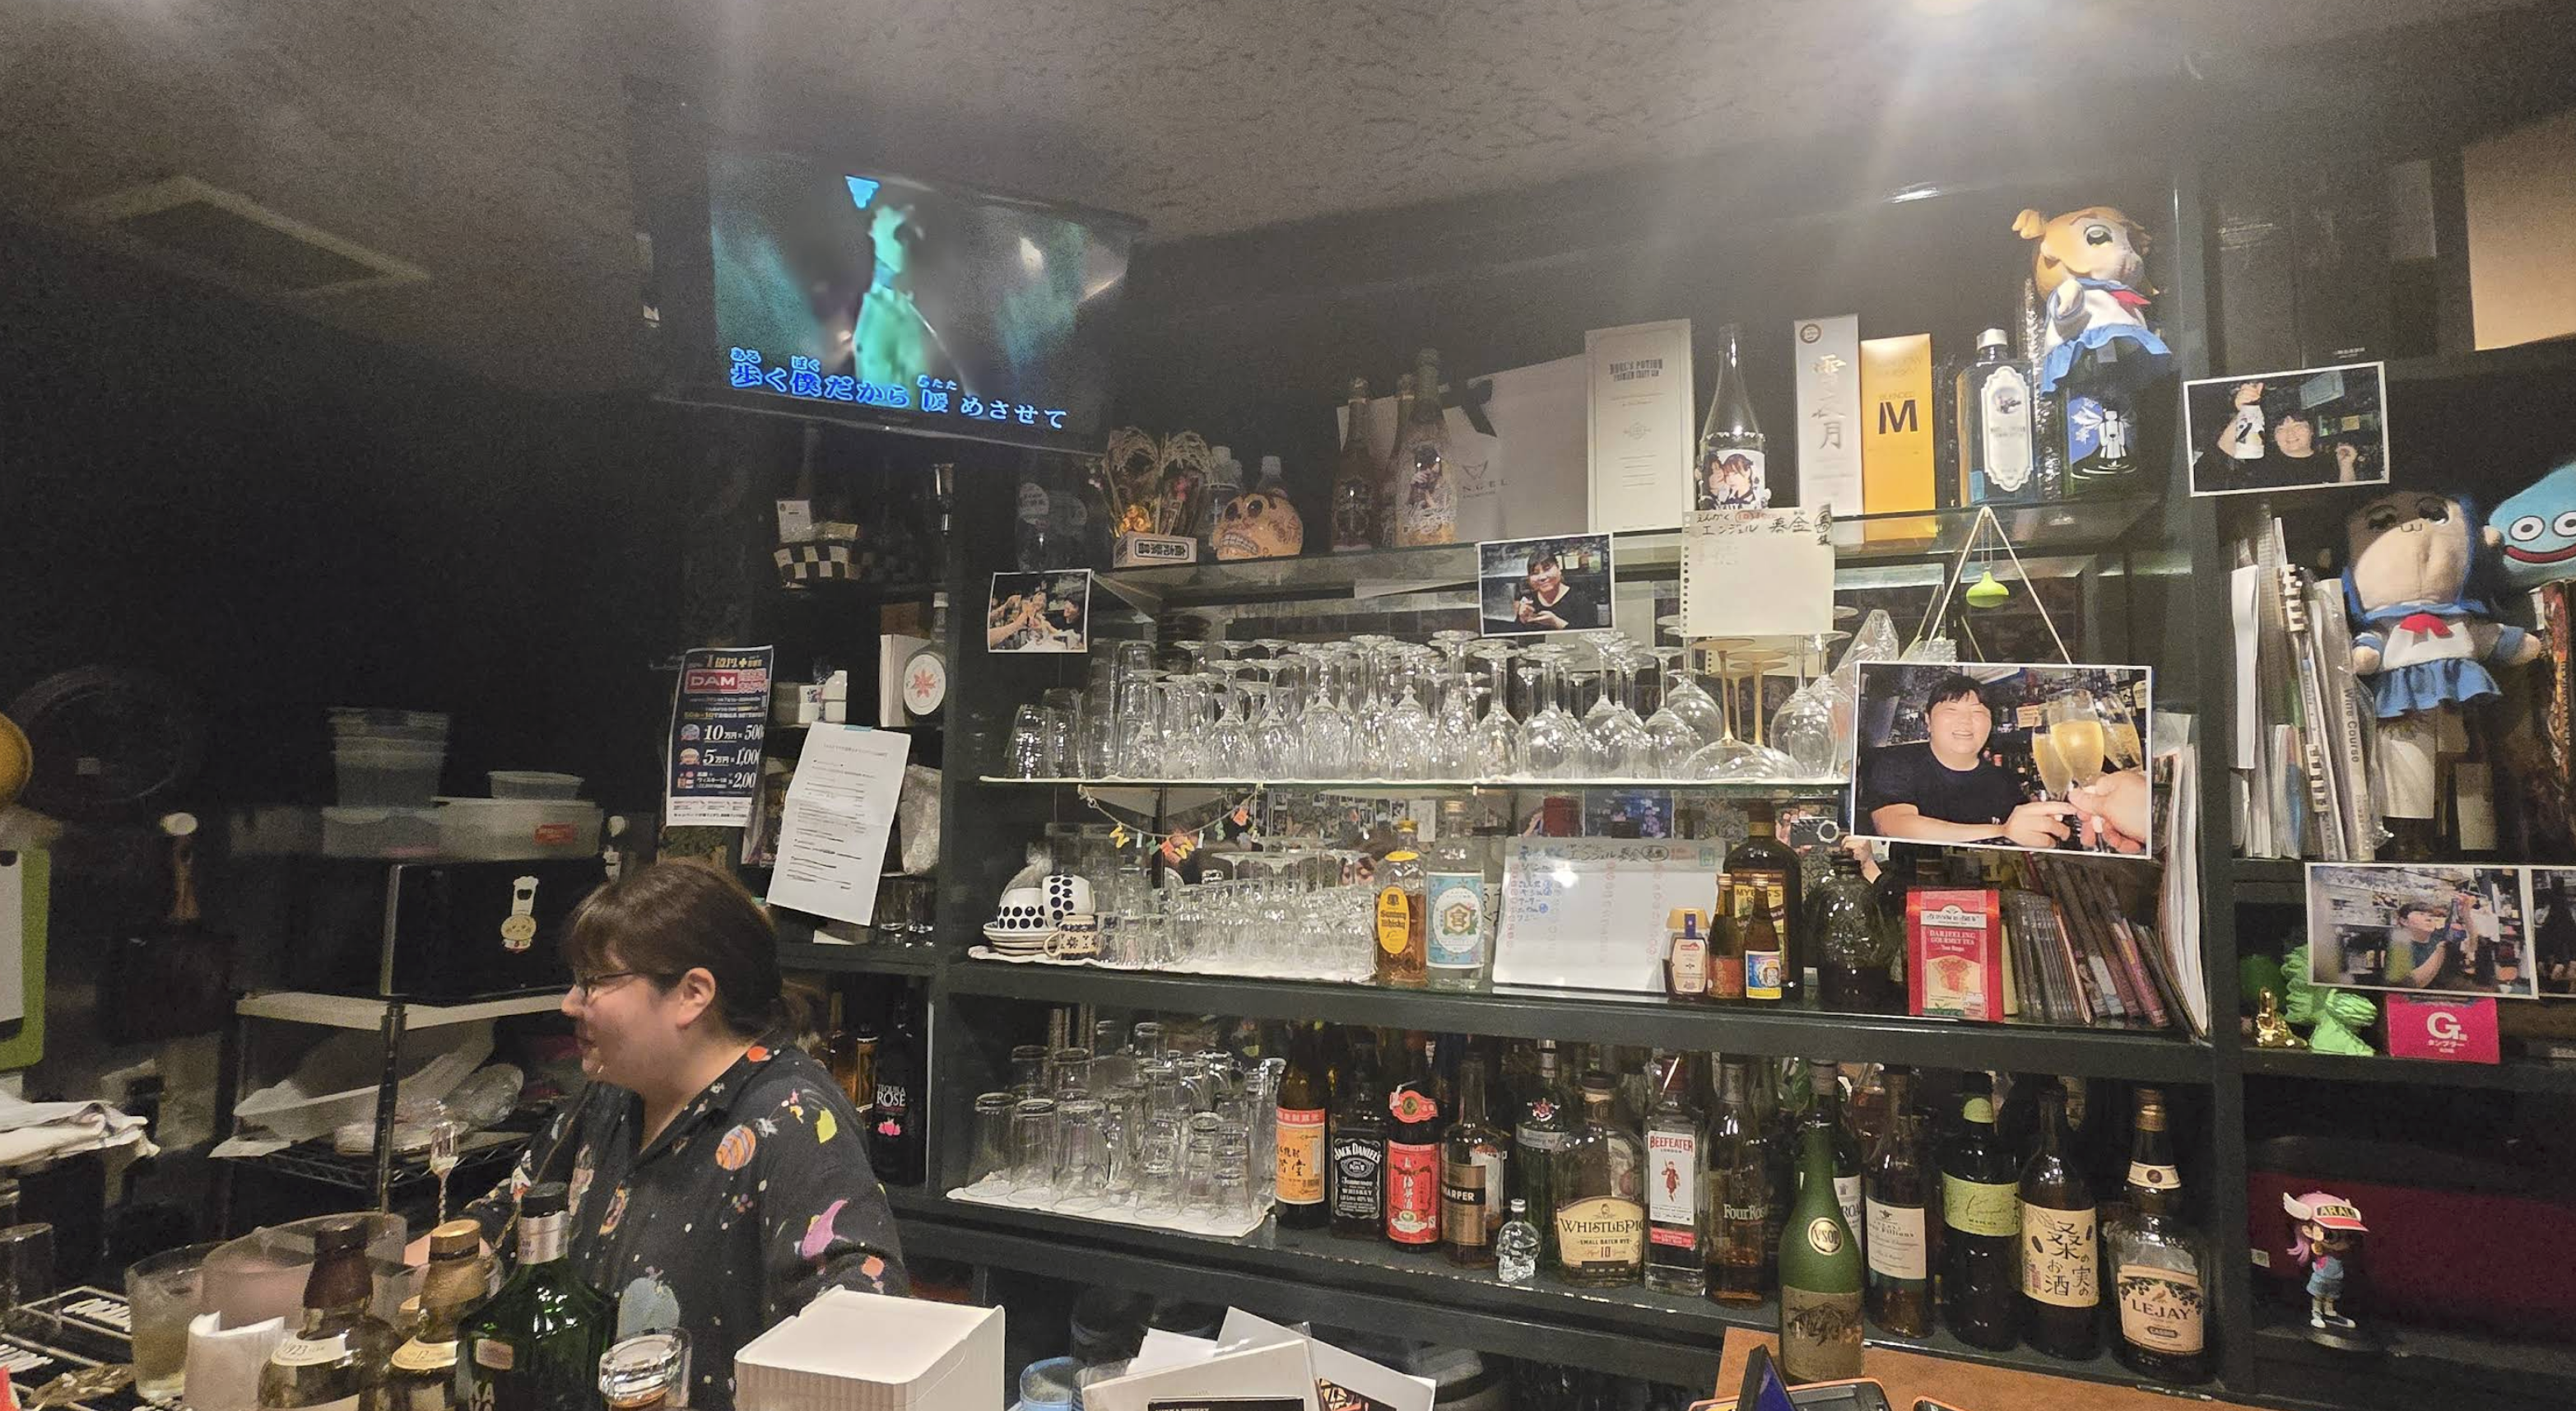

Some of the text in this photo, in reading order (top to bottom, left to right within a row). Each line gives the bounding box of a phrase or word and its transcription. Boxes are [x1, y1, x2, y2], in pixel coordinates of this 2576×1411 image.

[730, 347, 762, 363] ある
[791, 355, 821, 371] ぼく
[730, 362, 910, 408] 歩く僕だから
[1879, 399, 1918, 435] M
[690, 676, 736, 687] DAM
[2344, 688, 2353, 717] Wine
[702, 748, 729, 765] 5万円
[1929, 929, 1975, 938] DARJEELING
[876, 1092, 906, 1107] ROSE
[1649, 1135, 1693, 1152] BEEFEATER
[1334, 1143, 1382, 1164] JACK DANIEL'S
[1341, 1188, 1373, 1196] WHISKEY
[1723, 1204, 1749, 1220] Four
[1600, 1246, 1611, 1258] 10
[2132, 1299, 2191, 1320] LEJAY
